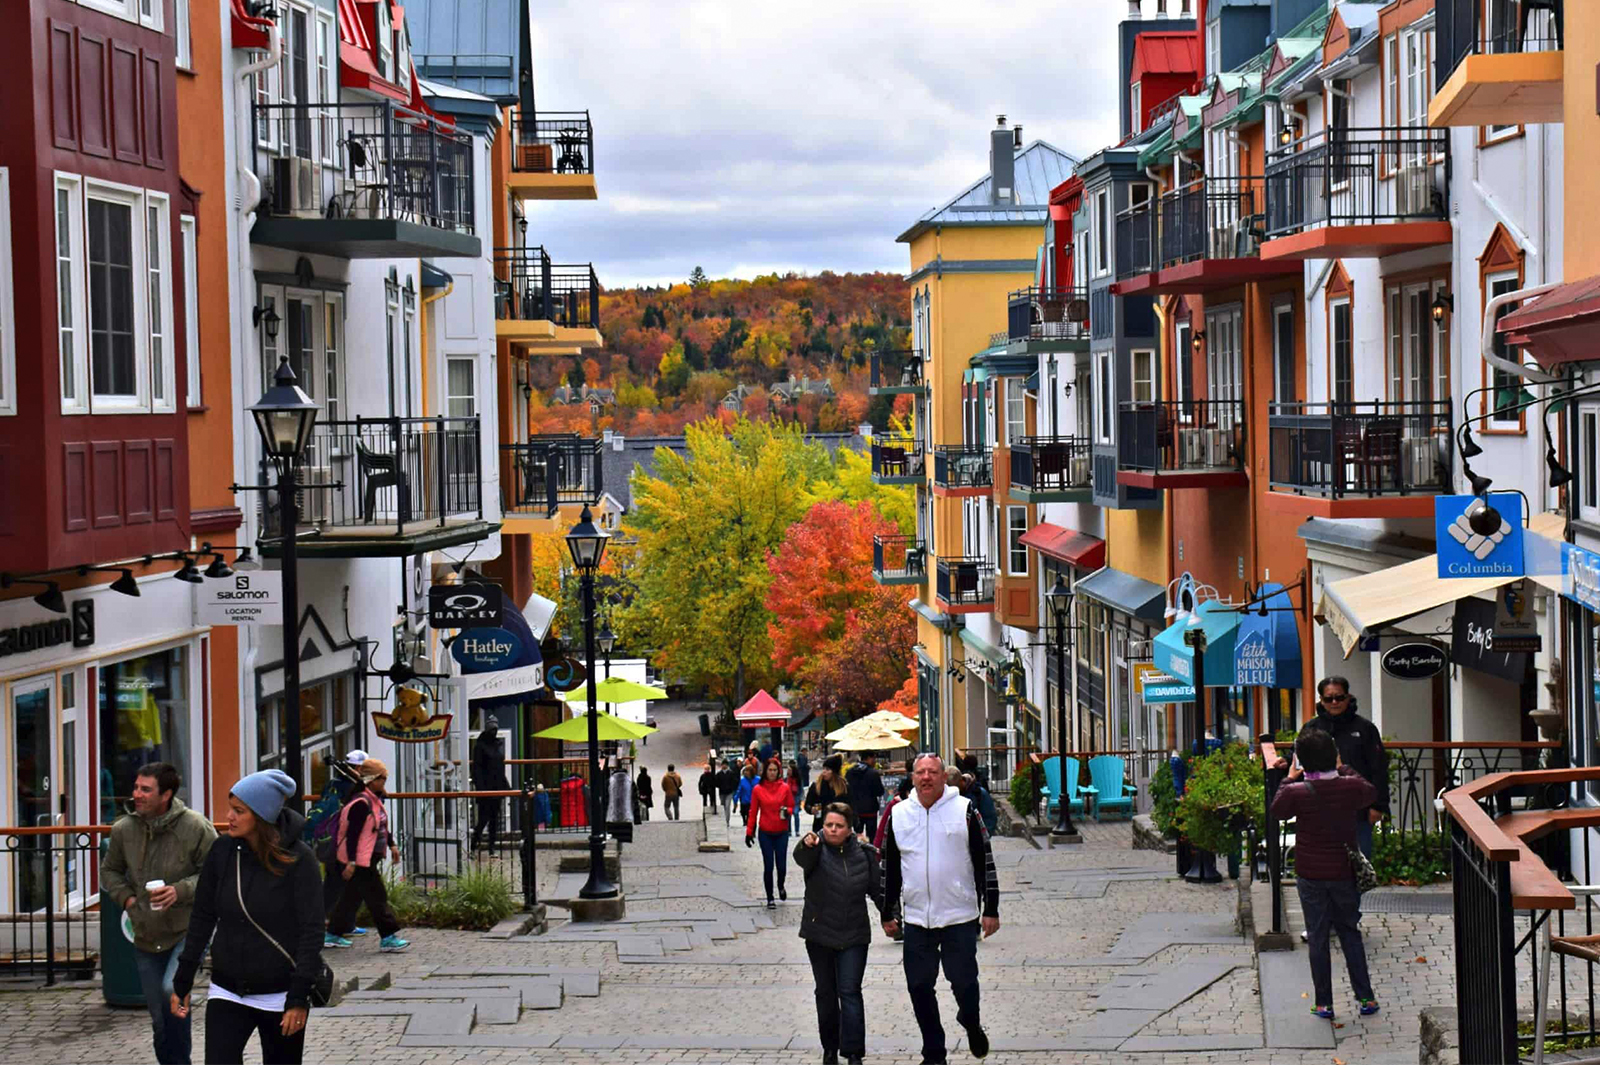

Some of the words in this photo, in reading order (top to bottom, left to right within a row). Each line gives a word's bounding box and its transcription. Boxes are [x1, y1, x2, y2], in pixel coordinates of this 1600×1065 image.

[1448, 562, 1513, 574] Columbia
[217, 591, 269, 600] salomon
[463, 638, 513, 657] Hatley
[1241, 640, 1268, 657] Petite
[1237, 658, 1274, 670] MAISON
[1237, 670, 1275, 684] BLEUE
